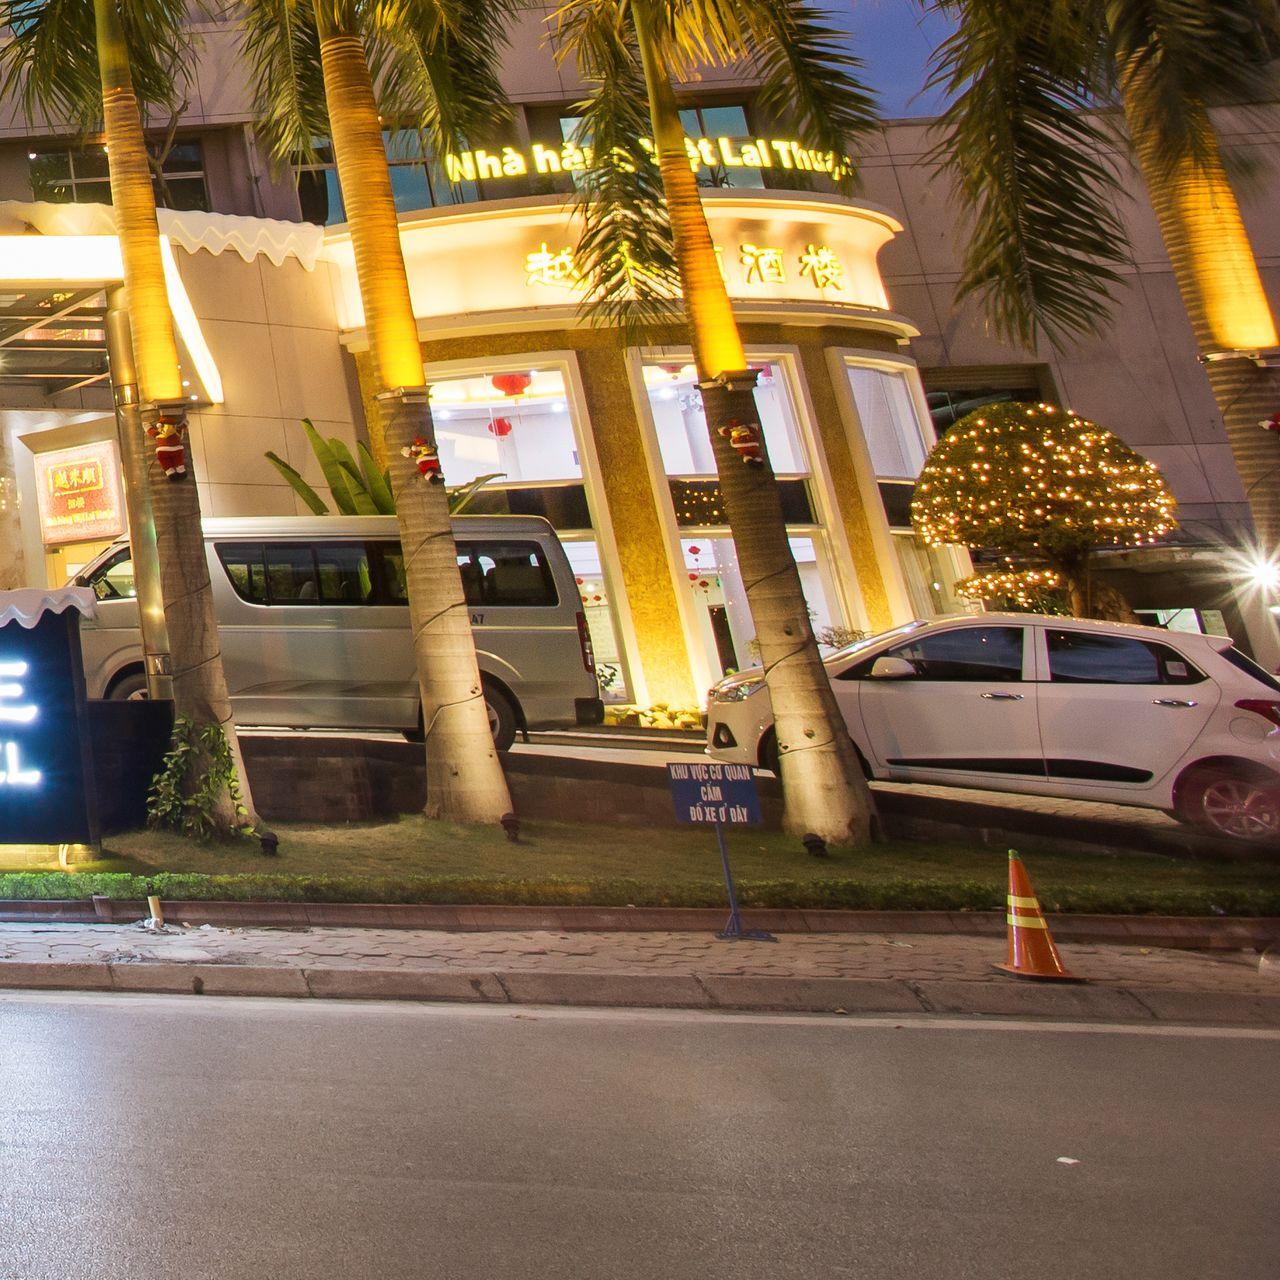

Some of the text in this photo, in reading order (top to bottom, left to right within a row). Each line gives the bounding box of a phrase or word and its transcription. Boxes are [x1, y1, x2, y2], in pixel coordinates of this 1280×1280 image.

[446, 146, 527, 182] Nhà
[669, 764, 689, 780] KHU
[724, 765, 751, 781] QUAN
[704, 807, 717, 822] XE
